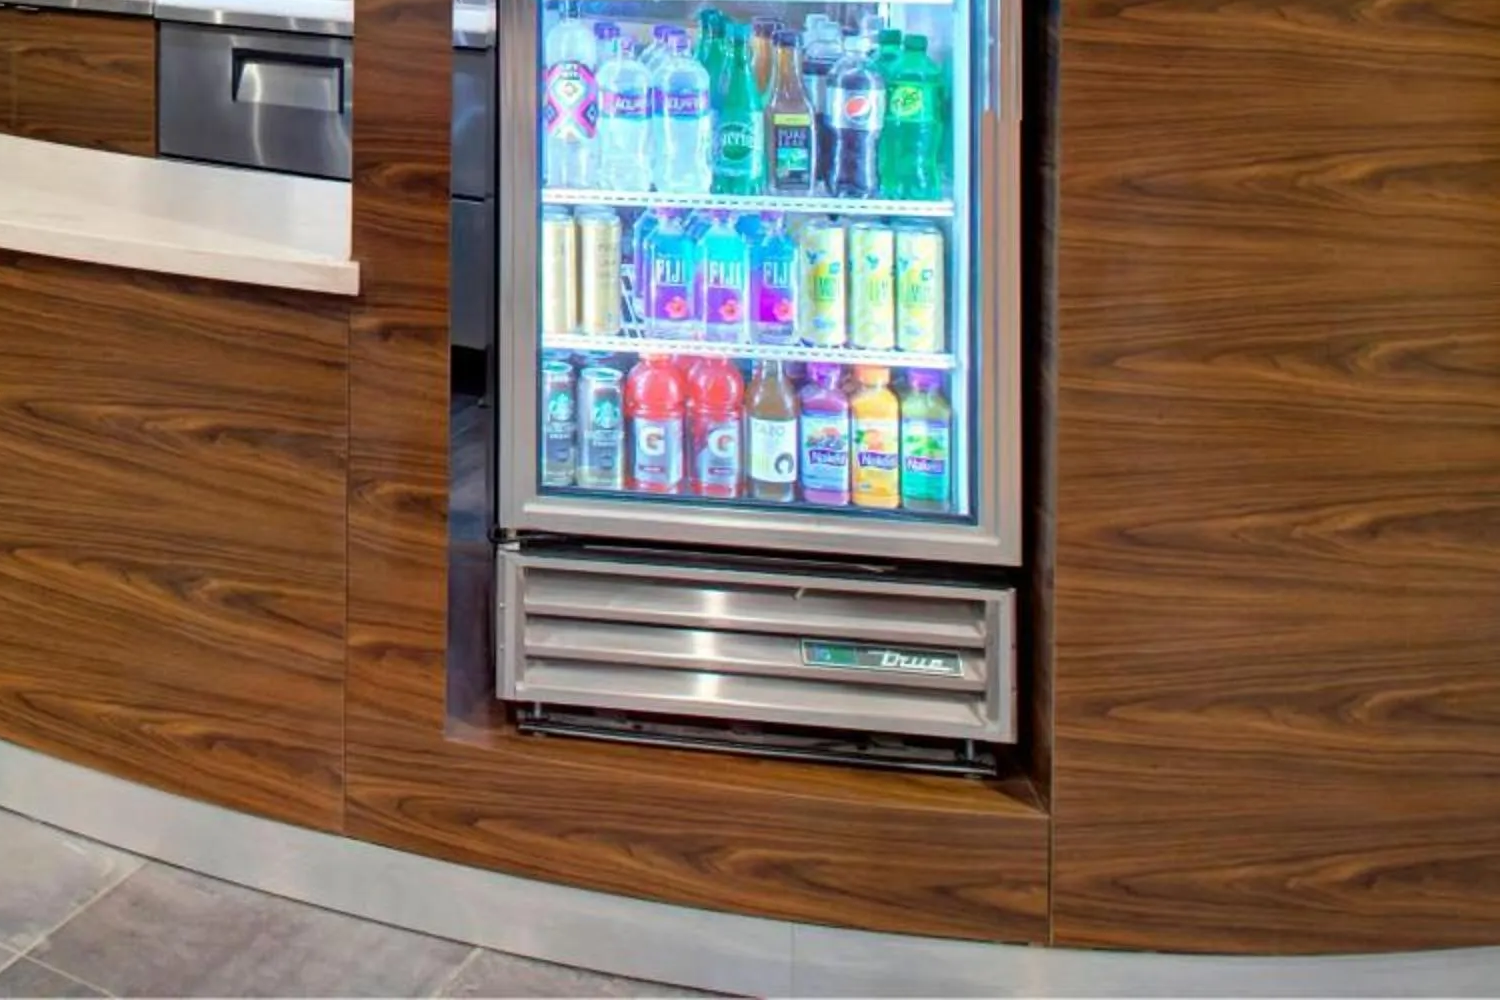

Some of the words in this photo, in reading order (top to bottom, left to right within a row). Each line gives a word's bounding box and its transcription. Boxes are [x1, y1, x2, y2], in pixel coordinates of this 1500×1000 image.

[655, 258, 686, 284] FIJI
[709, 260, 742, 286] FIJI
[638, 425, 665, 457] G
[707, 428, 738, 459] G
